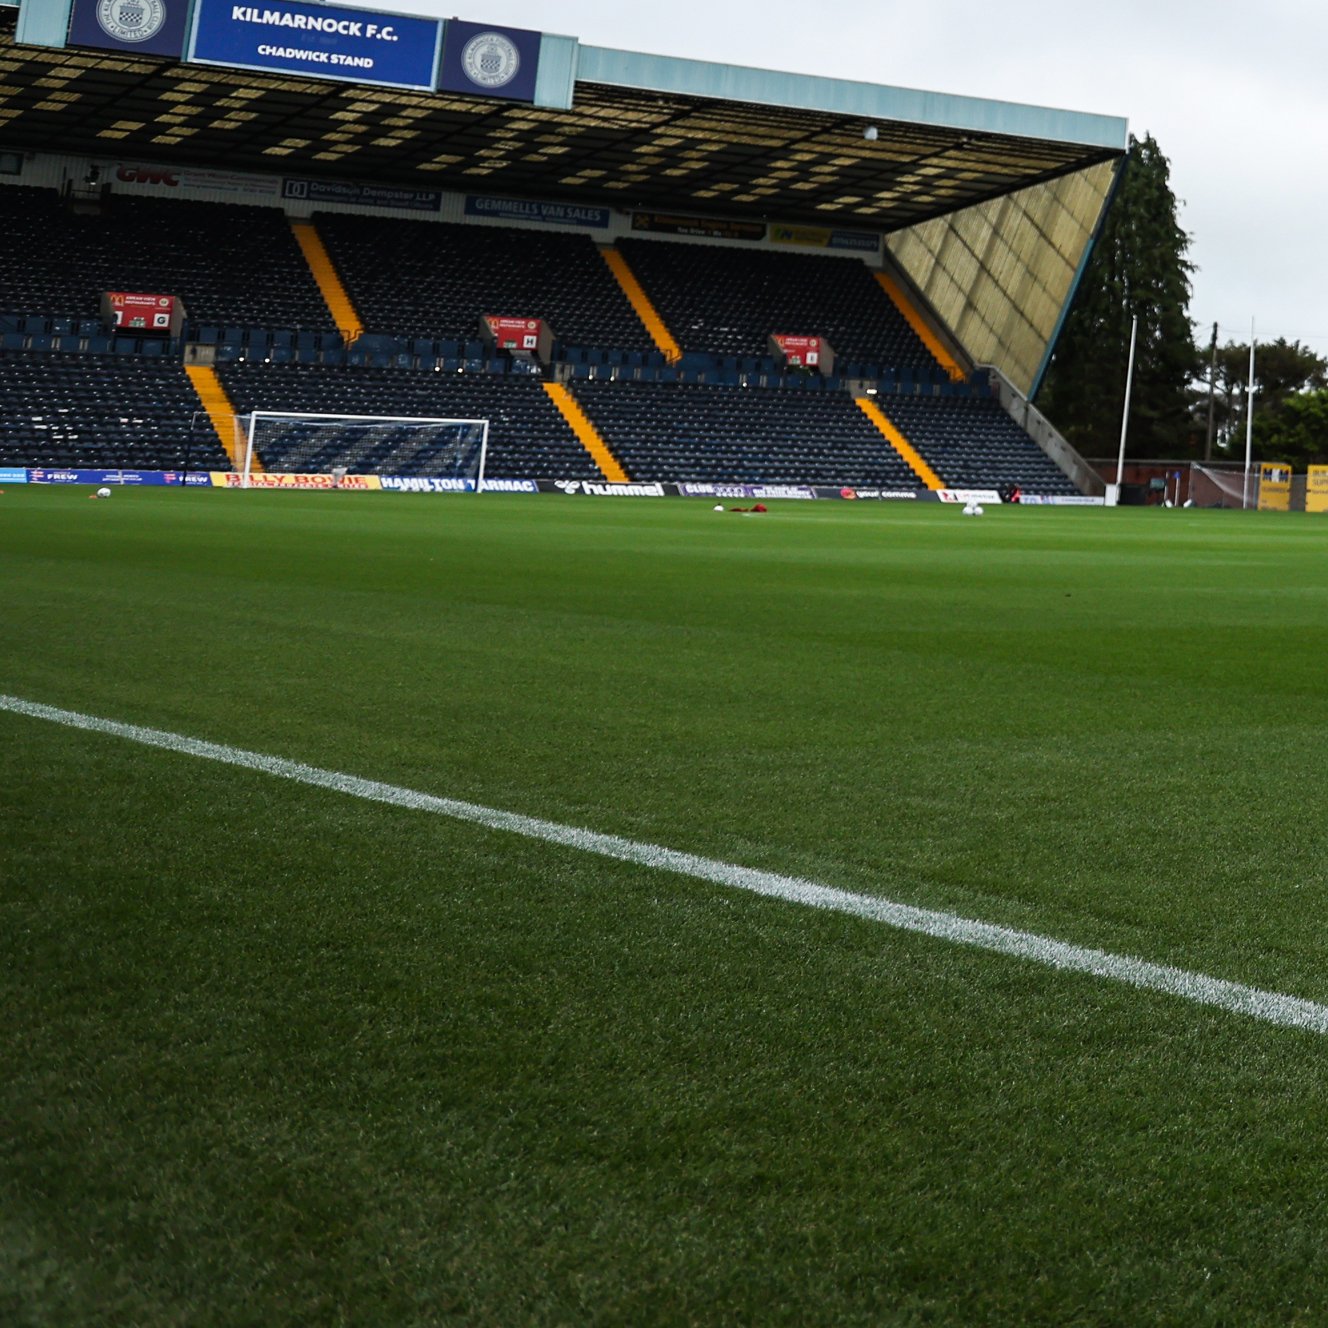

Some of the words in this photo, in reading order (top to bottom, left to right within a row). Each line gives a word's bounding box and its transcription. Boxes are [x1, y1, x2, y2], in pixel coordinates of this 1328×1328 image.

[232, 6, 362, 36] KILMARNOCK
[366, 24, 398, 42] F.C.
[257, 44, 330, 63] CHADWICK
[330, 53, 373, 68] STAND
[475, 198, 539, 215] GEMMELLS
[541, 204, 564, 217] VAN
[566, 208, 601, 221] SALES
[157, 316, 166, 325] G
[225, 474, 285, 483] BLLY
[380, 478, 464, 492] HAMILTON
[582, 480, 665, 496] hummel
